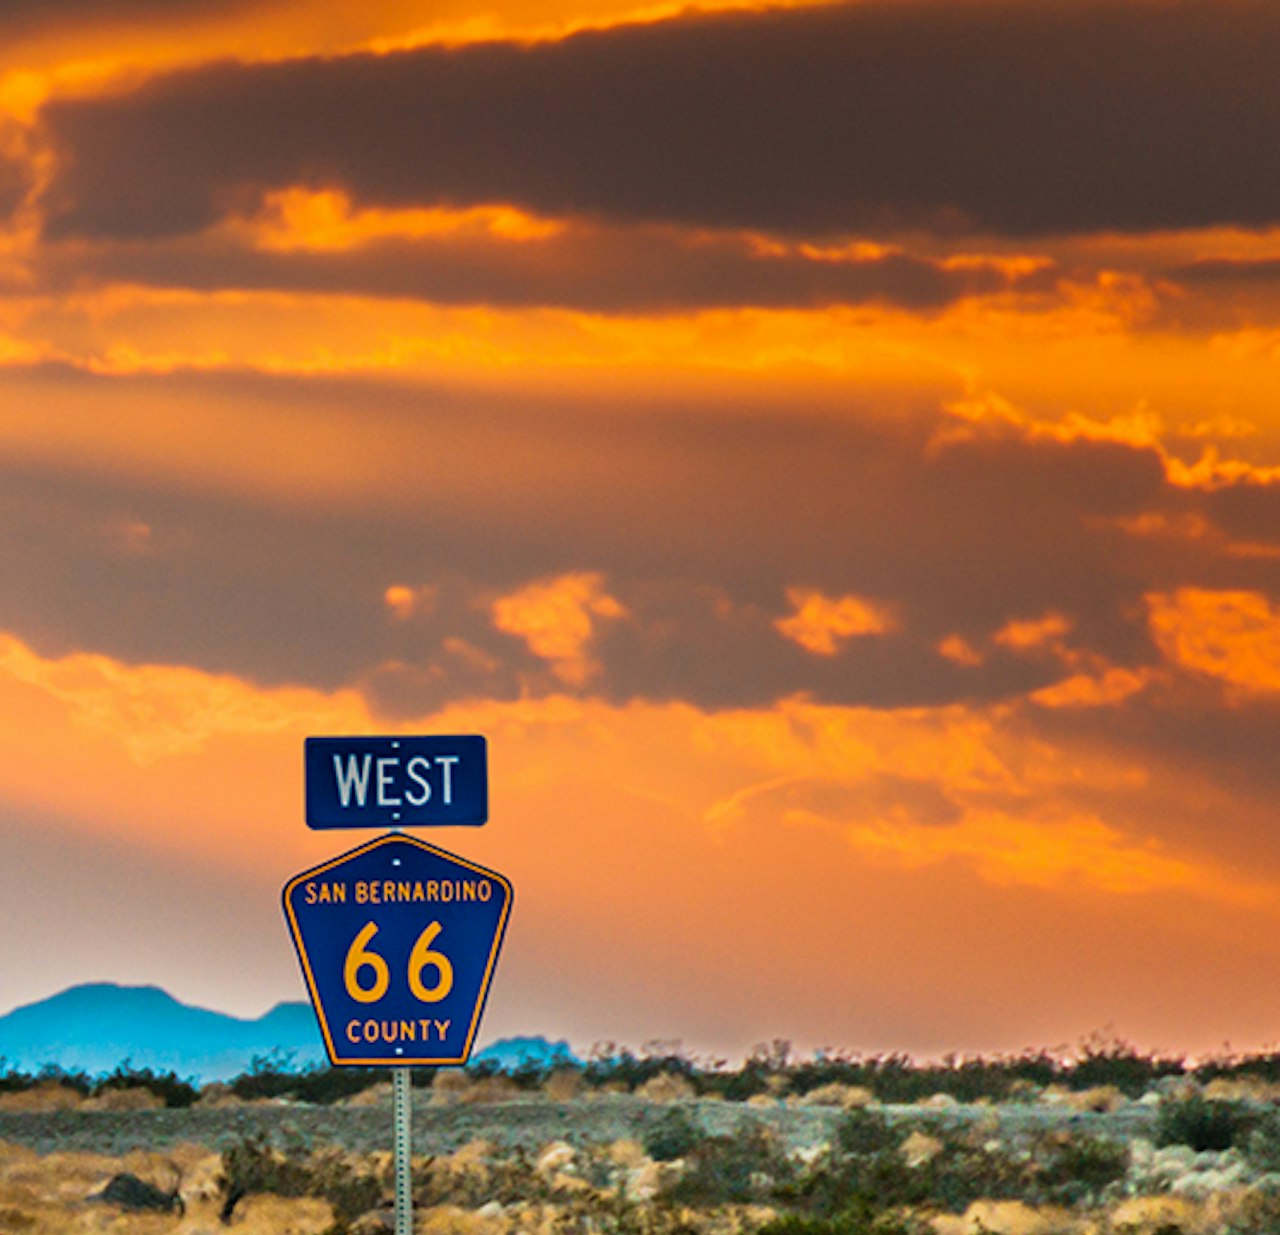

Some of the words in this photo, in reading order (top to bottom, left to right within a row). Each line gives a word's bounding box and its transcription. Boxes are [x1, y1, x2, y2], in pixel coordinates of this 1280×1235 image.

[334, 755, 459, 807] WEST
[305, 882, 346, 904] SAN
[355, 880, 491, 904] BERNARDINO
[344, 921, 454, 1003] 66
[346, 1020, 451, 1043] COUNTY
